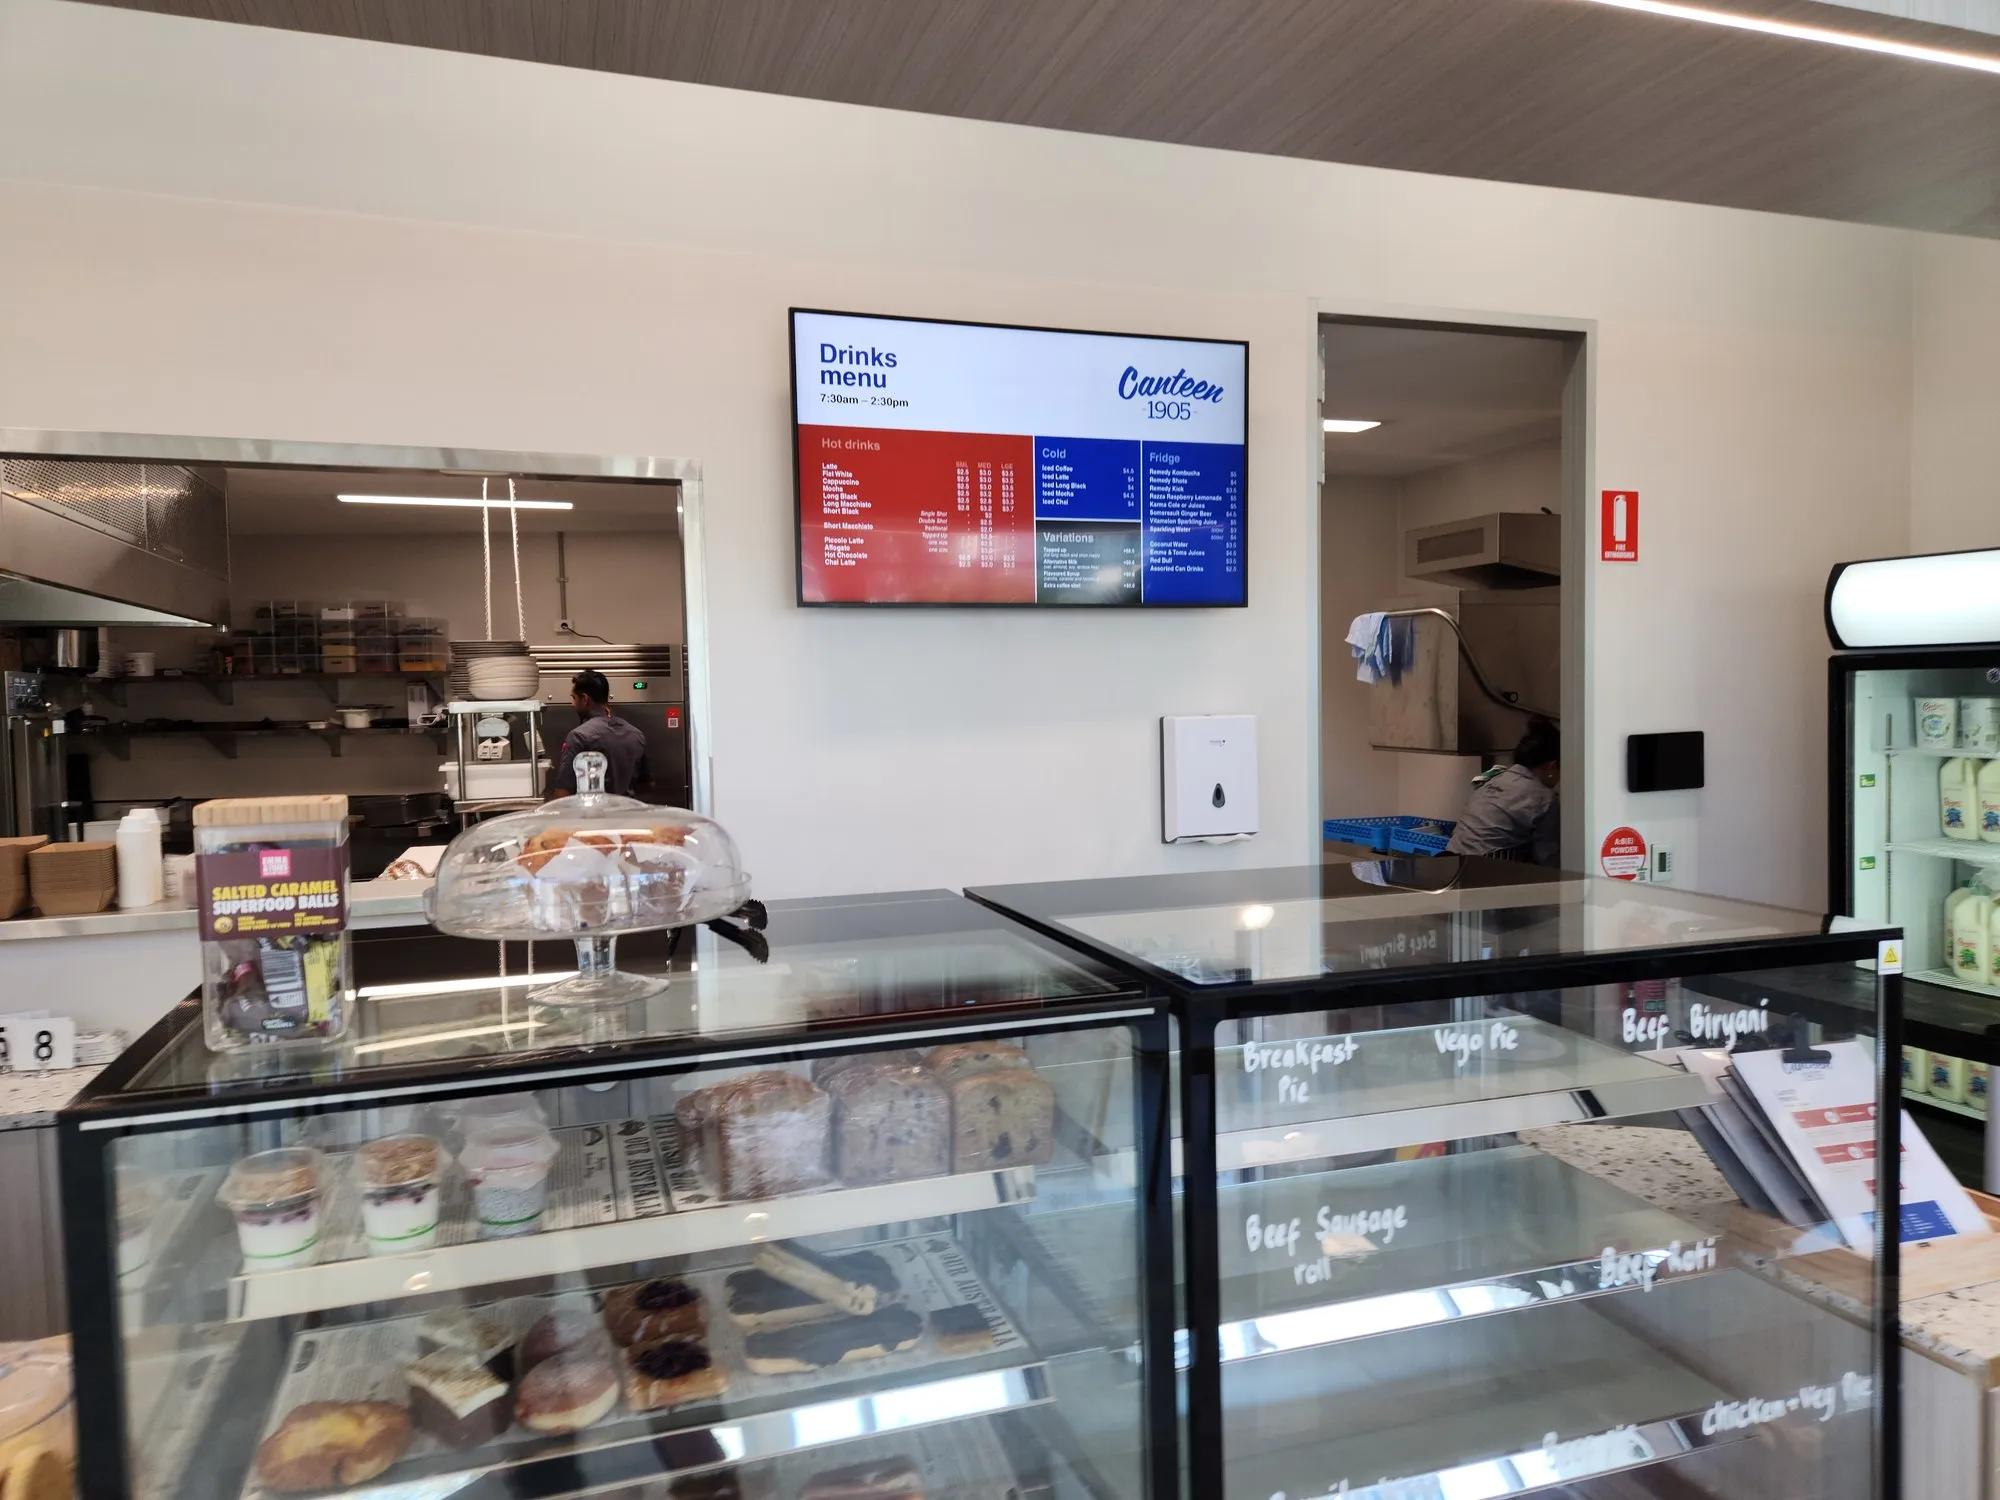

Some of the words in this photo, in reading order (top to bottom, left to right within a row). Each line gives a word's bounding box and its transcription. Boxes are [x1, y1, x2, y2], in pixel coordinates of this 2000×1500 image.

[820, 343, 898, 368] Drinks
[820, 369, 887, 388] menu
[1118, 365, 1224, 403] Canteen
[820, 393, 859, 404] 7:30am
[870, 396, 909, 408] 2:30pm
[1147, 400, 1191, 420] 1905
[822, 437, 841, 449] Hot
[845, 439, 880, 451] drinks
[1042, 448, 1067, 459] Cold
[1149, 452, 1180, 465] Fridge
[1172, 469, 1200, 477] Kombucha
[822, 478, 860, 486] Cappuccino
[1055, 482, 1070, 490] Long
[1149, 477, 1171, 485] Remedy
[1149, 485, 1171, 493] Remedy
[823, 493, 839, 501] Long
[823, 500, 839, 508] Long
[840, 500, 872, 508] Macchiato
[1181, 510, 1198, 518] Ginger
[1177, 518, 1202, 526] Sparkling
[1149, 526, 1175, 534] Sparkling
[1043, 532, 1094, 543] Variations
[824, 544, 850, 552] Affogato
[1610, 846, 1639, 854] POWDER
[212, 884, 267, 901] SALTED
[270, 880, 338, 897] CARAMEL
[212, 896, 296, 915] SUPERFOOD
[298, 893, 339, 910] BALLS
[1622, 1008, 1670, 1051] Beef
[1690, 998, 1769, 1050] Biryani
[34, 1030, 53, 1061] 8
[1434, 1029, 1483, 1067] Vego
[1490, 1022, 1519, 1051] Pie
[1243, 1035, 1359, 1073] Breakfast
[1278, 1074, 1310, 1104] Pie
[1246, 1213, 1300, 1257] Beef
[1315, 1205, 1408, 1245] Sausage
[1294, 1256, 1332, 1285] roll
